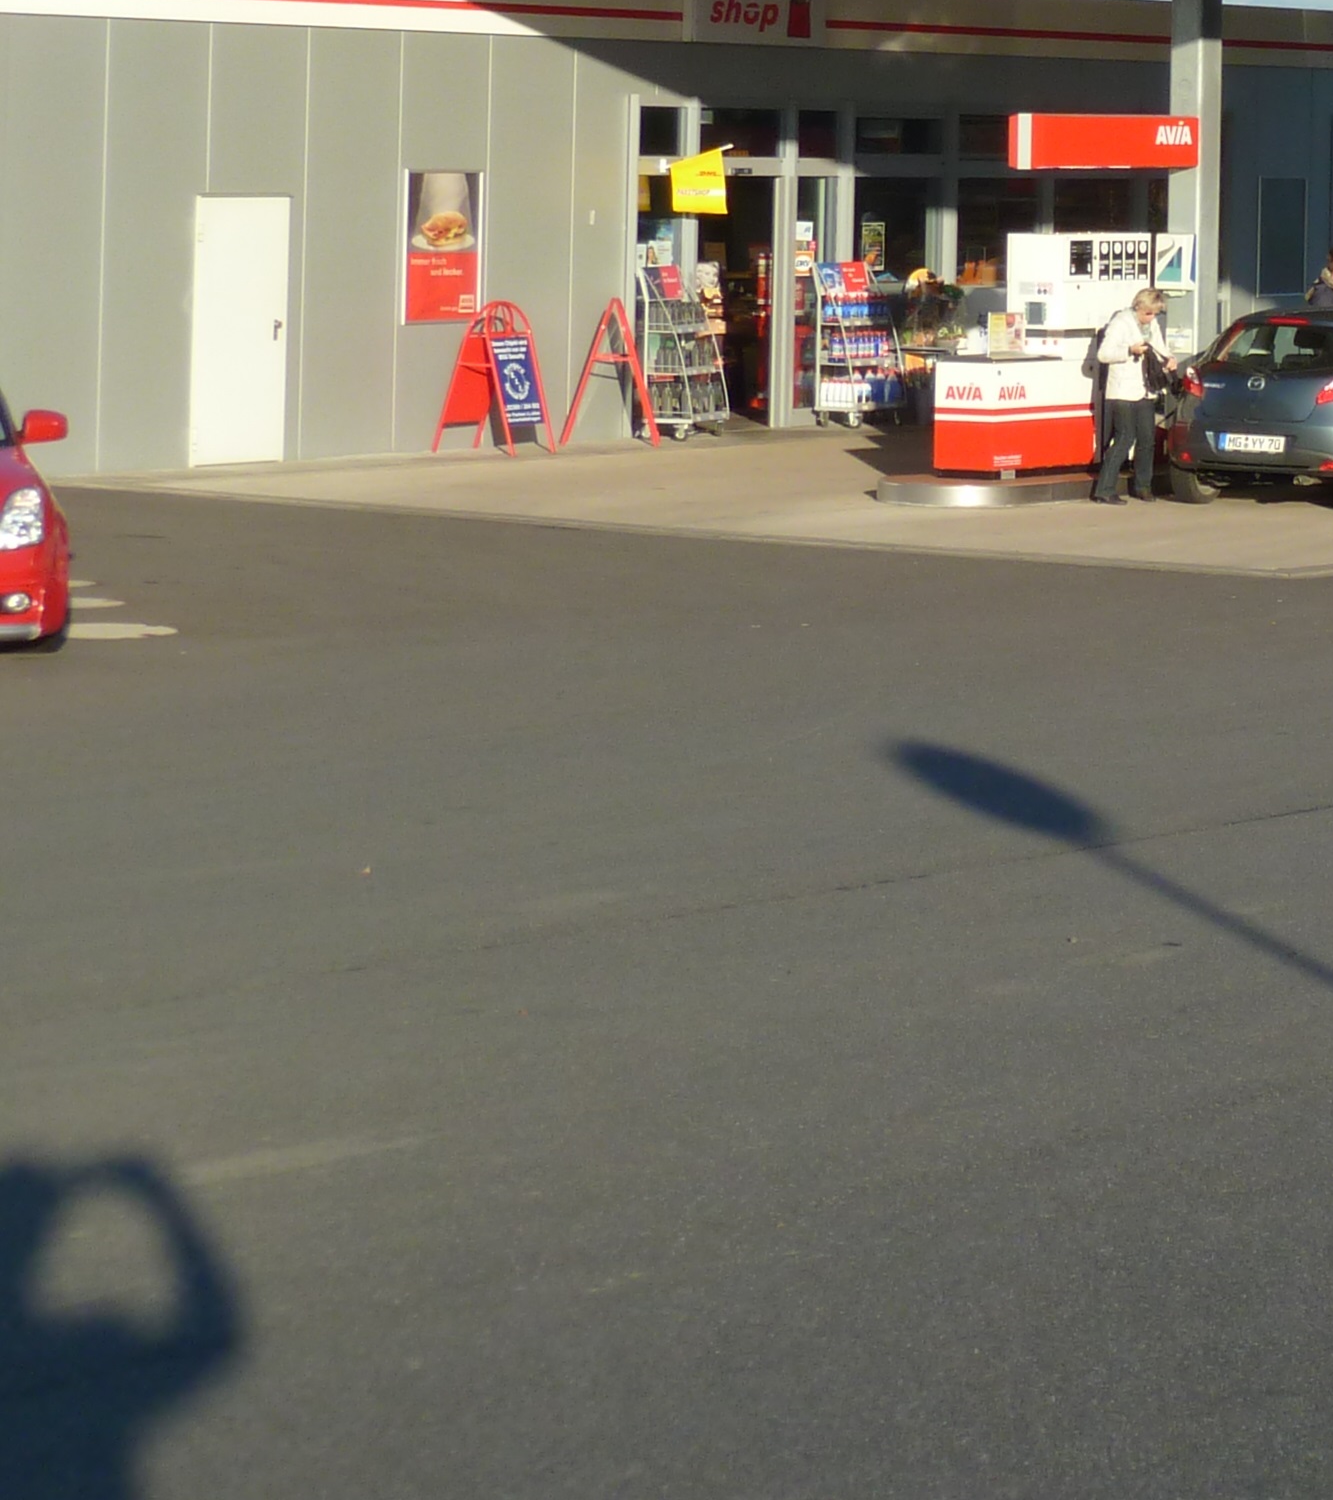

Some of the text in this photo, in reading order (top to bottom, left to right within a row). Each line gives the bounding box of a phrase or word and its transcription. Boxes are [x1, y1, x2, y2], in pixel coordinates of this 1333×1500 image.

[1155, 120, 1193, 145] AVIA
[945, 382, 983, 401] AVIA
[998, 382, 1026, 401] AVIA
[1227, 436, 1281, 450] MG YY 70
